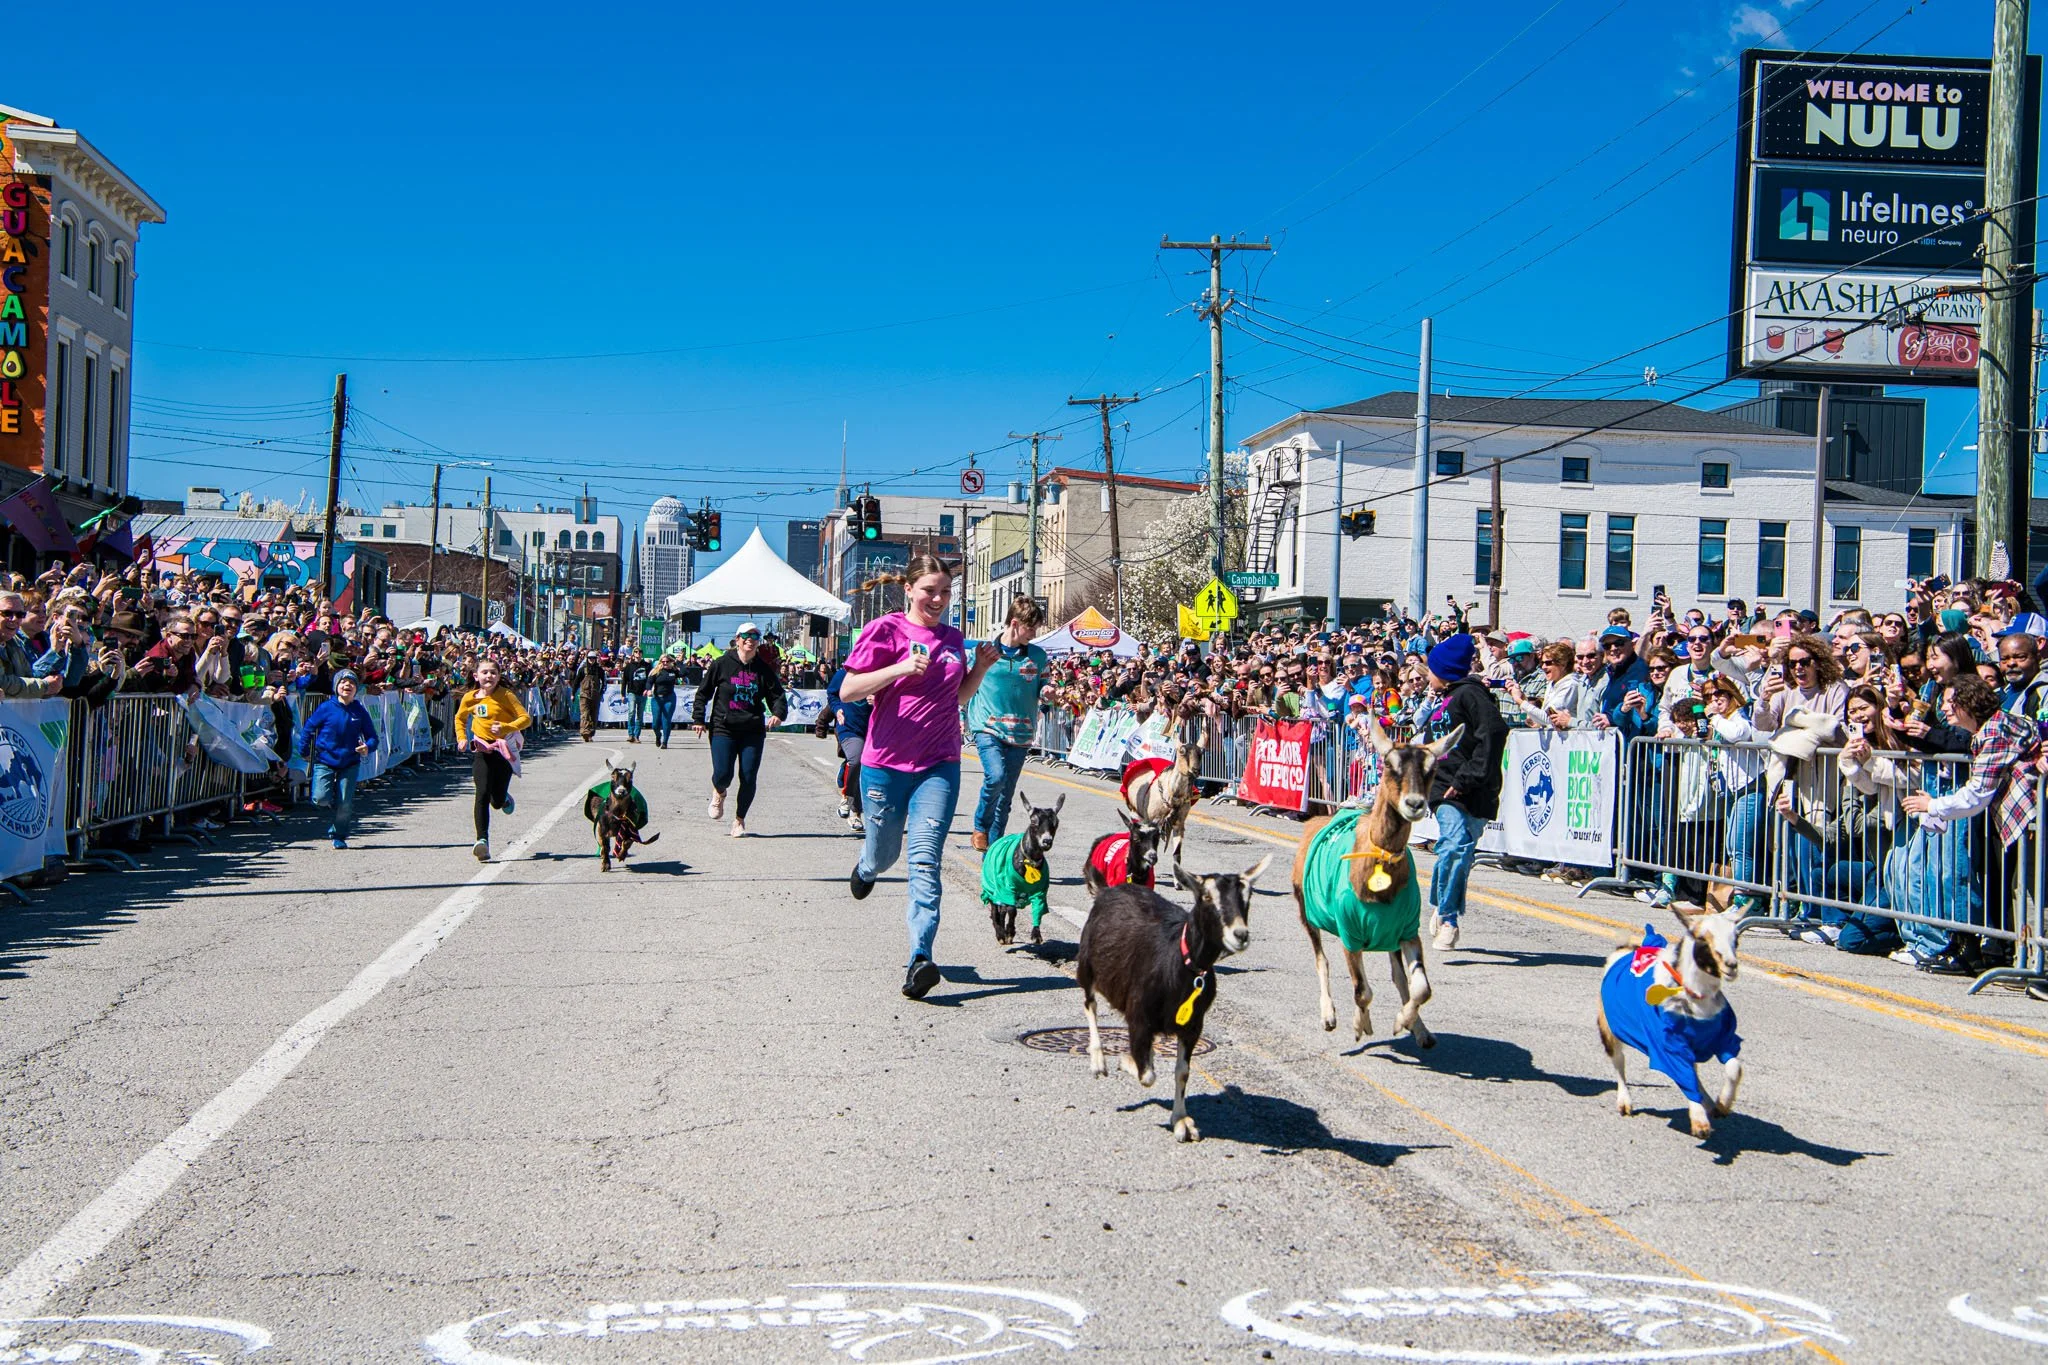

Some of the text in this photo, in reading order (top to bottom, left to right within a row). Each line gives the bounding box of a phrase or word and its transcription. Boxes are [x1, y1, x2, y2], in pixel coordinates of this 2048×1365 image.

[1805, 79, 1962, 104] WELCOME to
[1805, 103, 1960, 150] NULU
[1841, 228, 1898, 245] neuro
[1764, 280, 1901, 315] AKASHA
[1231, 574, 1267, 586] Campbell
[1, 815, 31, 835] FARM
